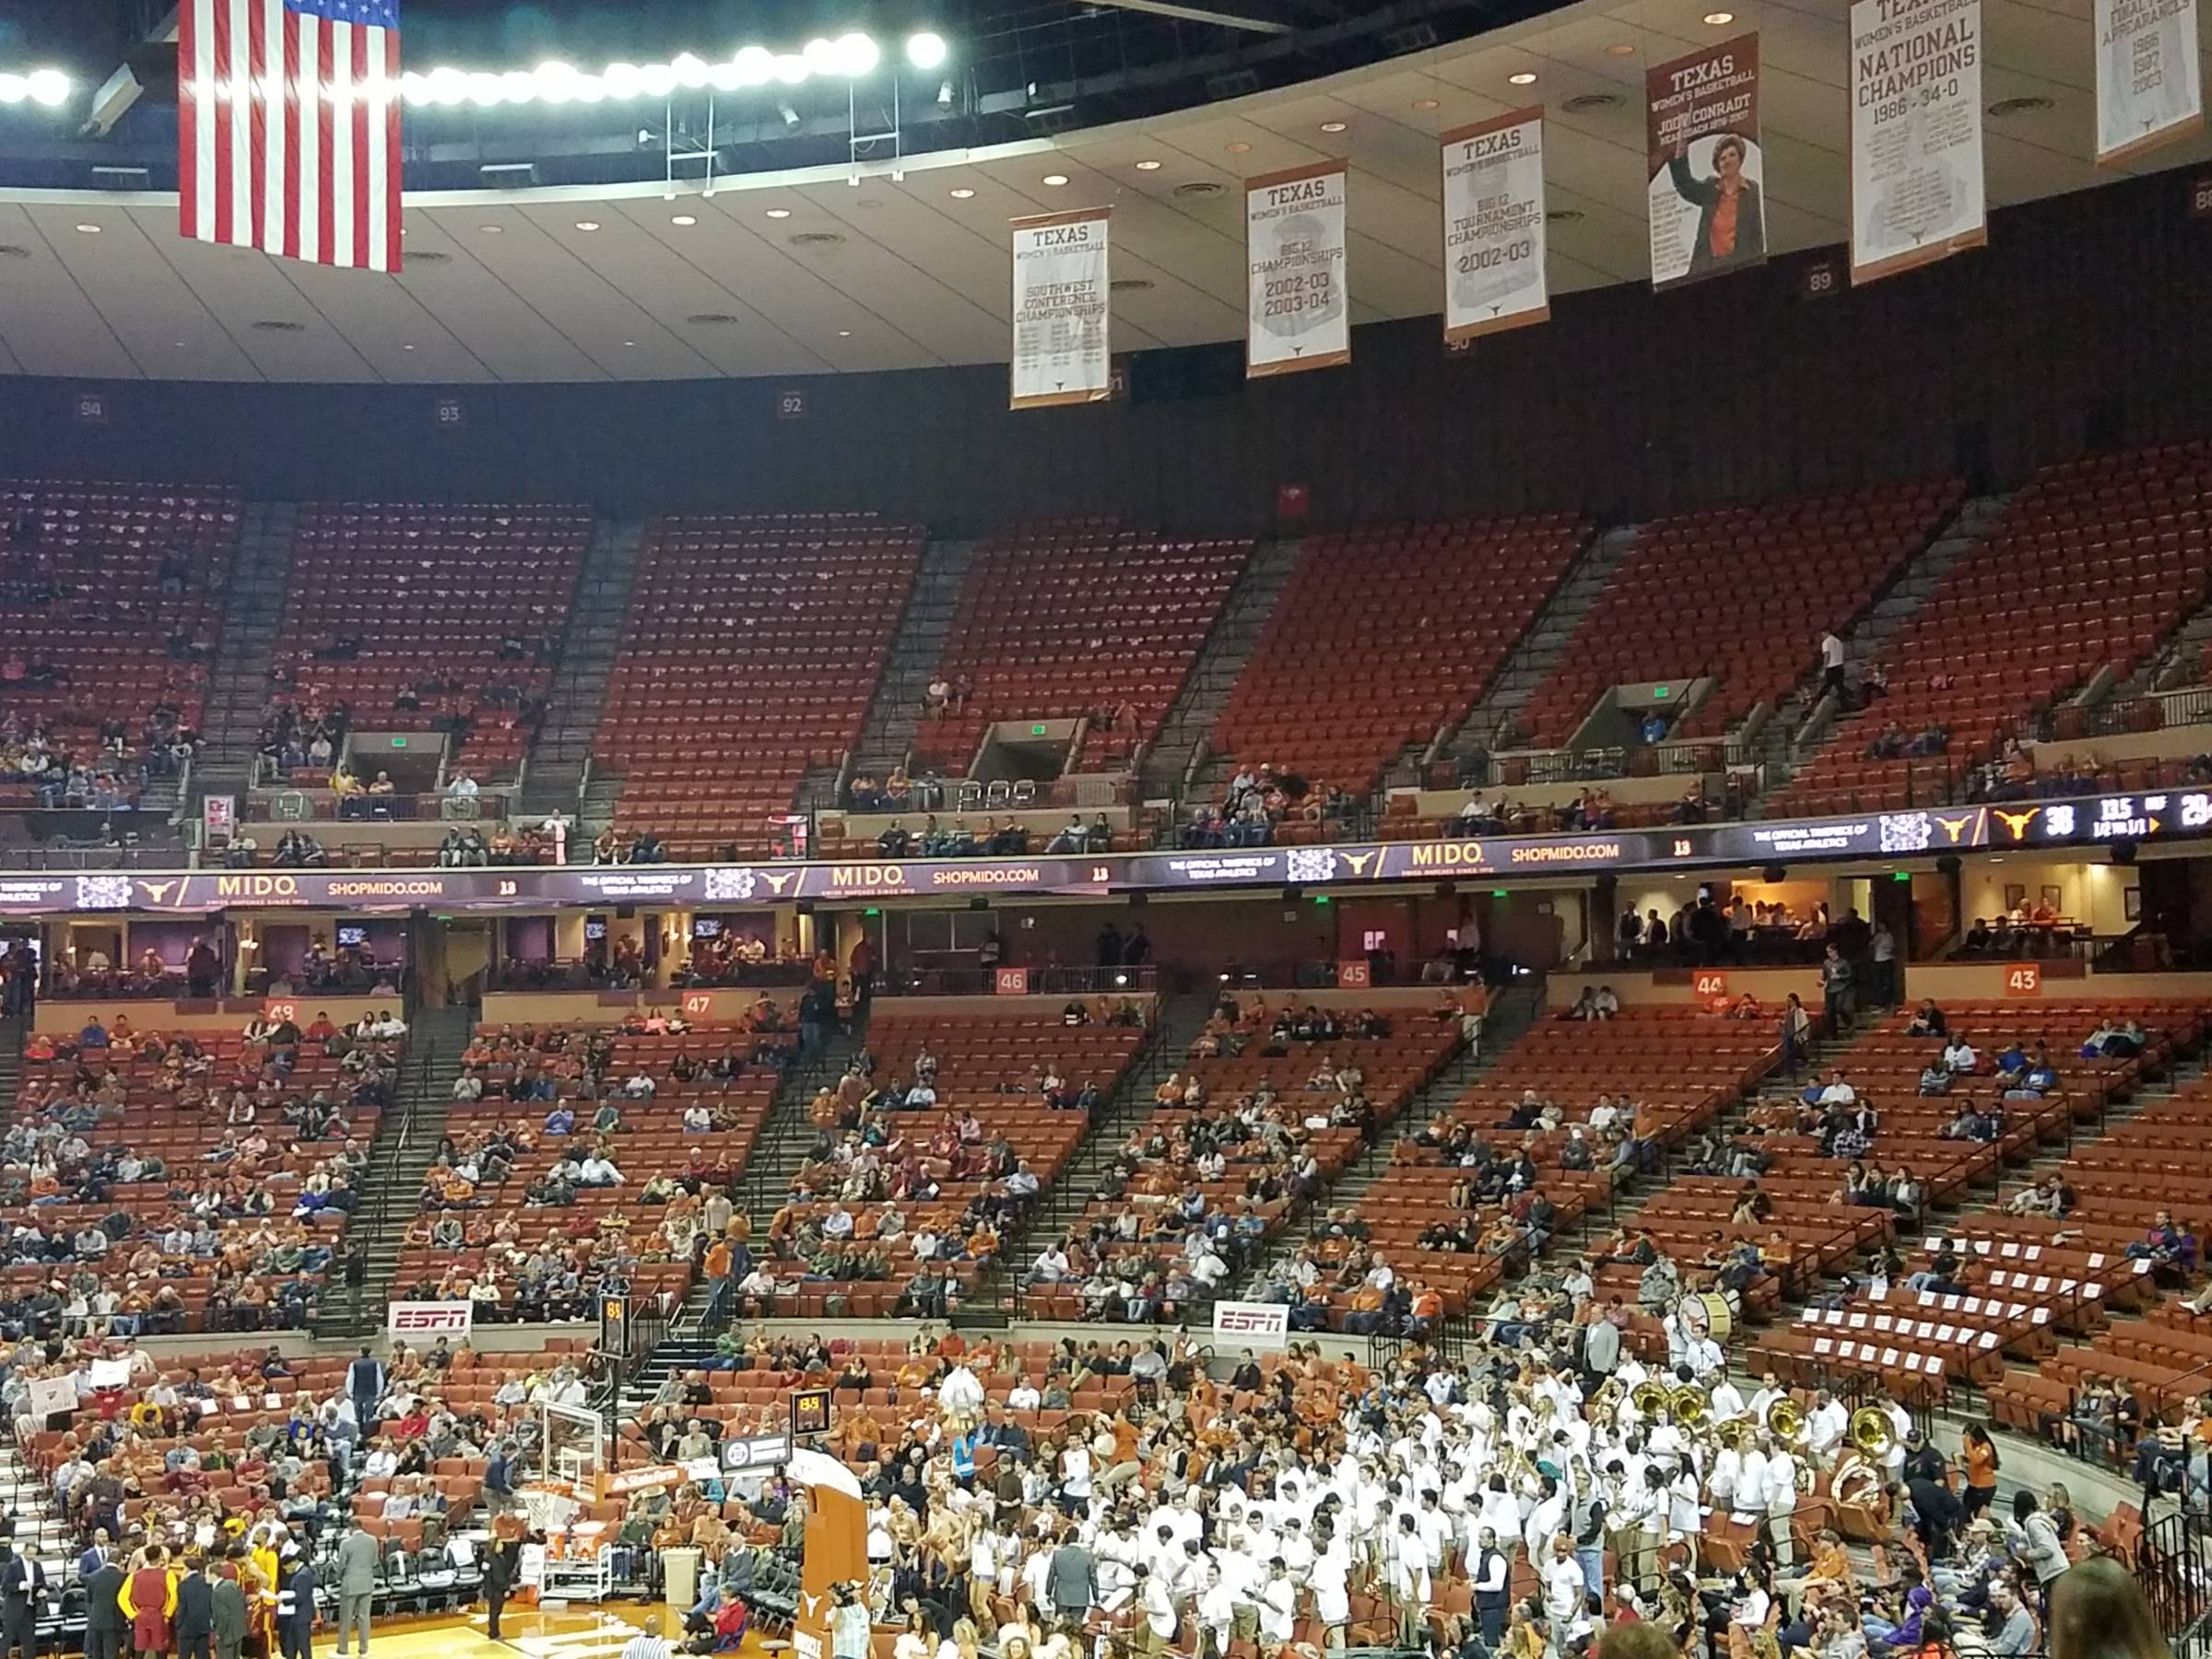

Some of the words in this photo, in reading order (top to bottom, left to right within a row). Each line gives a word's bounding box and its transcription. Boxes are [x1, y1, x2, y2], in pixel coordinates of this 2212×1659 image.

[1854, 20, 1902, 49] WOMEN'S
[1859, 18, 1974, 82] NATIONAL
[1671, 55, 1734, 91] TEXAS
[1858, 44, 1975, 107] CHAMPIONS
[1651, 90, 1693, 112] WOMEN'S
[1694, 69, 1756, 99] BASKETBALL
[1692, 93, 1751, 124] CONRADT
[1874, 98, 1908, 125] 1986
[1464, 129, 1522, 160] TEXAS
[1268, 180, 1325, 206] TEXAS
[1498, 194, 1510, 206] 12
[1288, 195, 1344, 215] BASKETBALL
[1453, 200, 1535, 231] TOURNAMENT
[1033, 225, 1088, 247] TEXAS
[1447, 212, 1541, 247] CHAMPIONSHIPS
[1301, 241, 1313, 253] 12
[1459, 241, 1530, 274] 2002-03
[1252, 247, 1344, 275] CHAMPIONSHIPS
[1027, 279, 1095, 298] SOUTHWEST
[1265, 272, 1329, 298] 2002-03
[1810, 272, 1831, 290] 89
[1024, 291, 1097, 310] CONFERENCE
[1265, 291, 1329, 316] 2003-04
[1016, 302, 1106, 323] CHAMPIONSHIPS
[783, 397, 802, 413] 92
[1512, 844, 1619, 863] SHOPMIDO.COM
[1674, 841, 1691, 856] 13
[933, 869, 1039, 884] SHOPMIDO.COM
[328, 882, 442, 896] SHOPMIDO.COM
[1001, 973, 1022, 988] 46
[1343, 967, 1365, 982] 45
[2010, 971, 2035, 990] 43
[1698, 977, 1723, 994] 44
[688, 996, 710, 1012] 47
[395, 1310, 466, 1328] ESPN
[1220, 1311, 1282, 1332] ESPN
